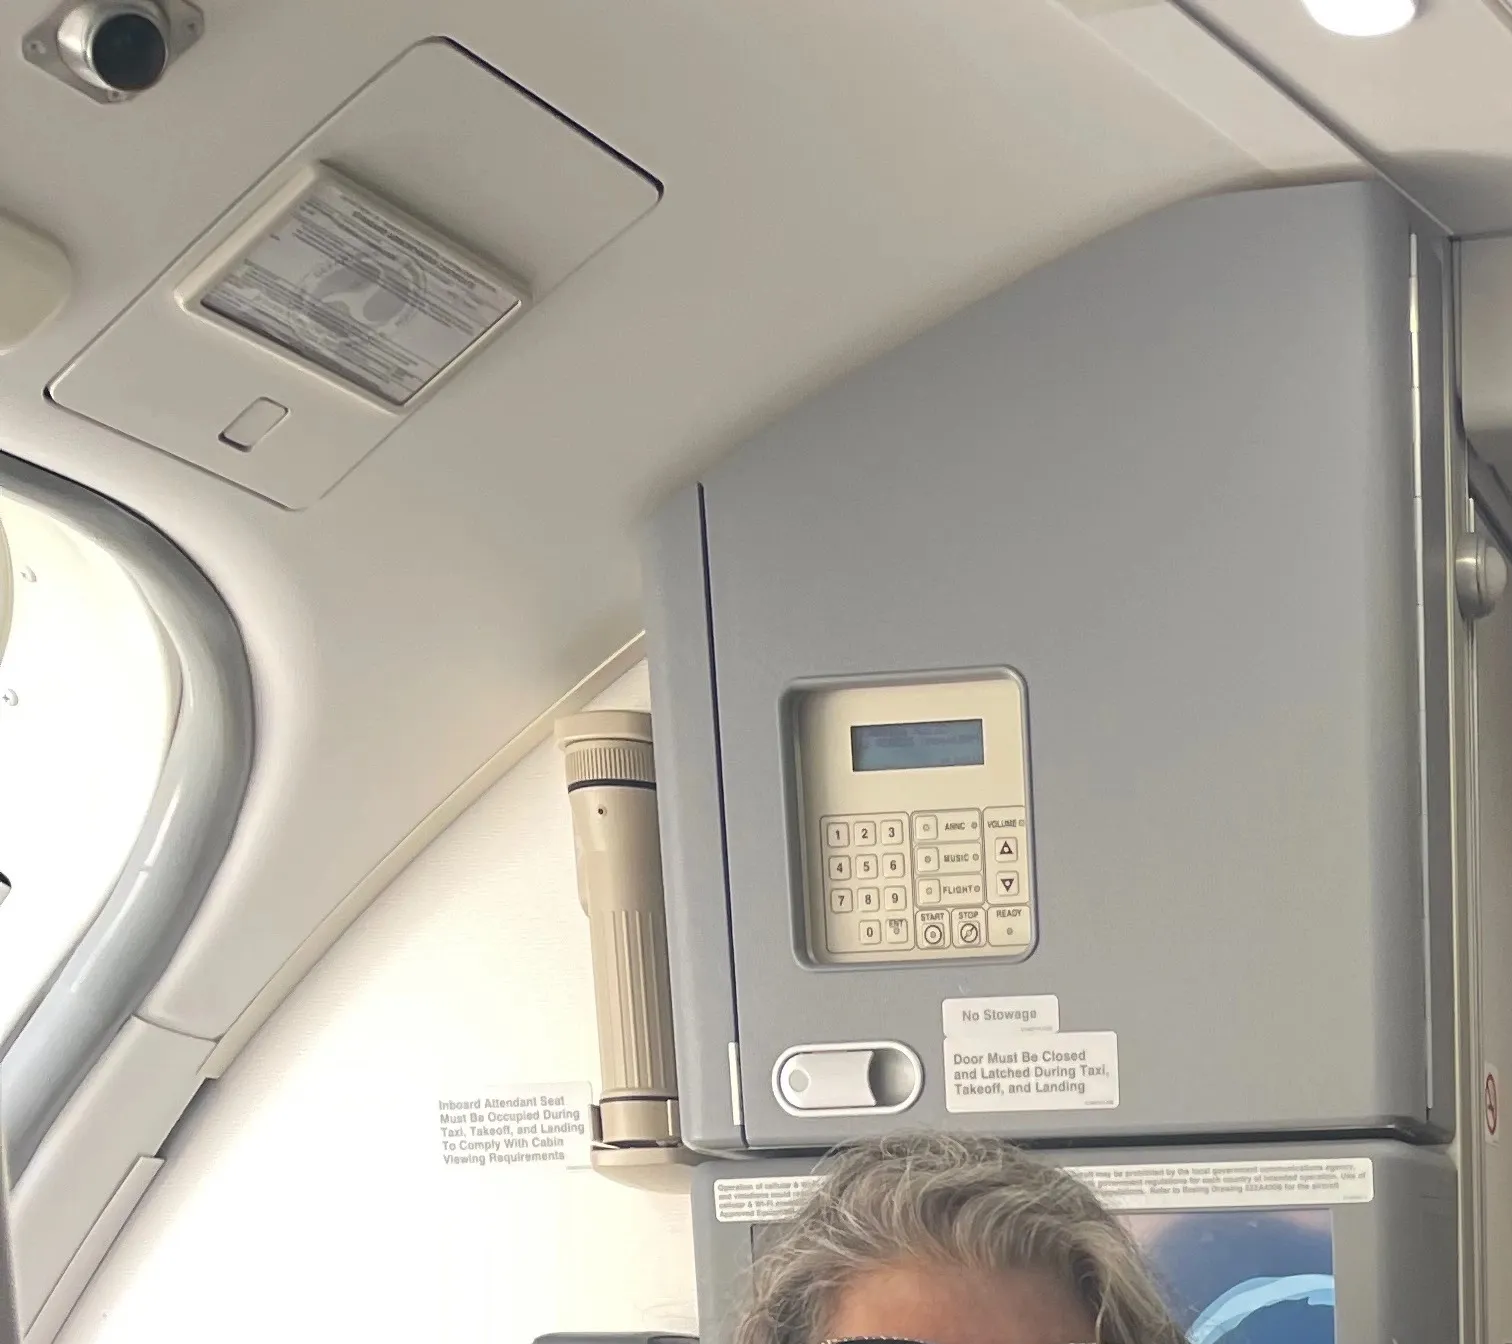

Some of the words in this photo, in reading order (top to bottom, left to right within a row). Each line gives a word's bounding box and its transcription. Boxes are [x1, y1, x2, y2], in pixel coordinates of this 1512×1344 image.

[987, 819, 1017, 829] VOLUME
[835, 830, 840, 840] 1
[861, 828, 869, 839] 2
[888, 827, 895, 838] 3
[943, 853, 970, 863] MUSIC
[836, 862, 843, 873] 4
[863, 861, 870, 872] 5
[889, 860, 897, 871] 6
[942, 884, 973, 894] FLIGHT
[838, 896, 845, 906] 7
[864, 894, 872, 905] 8
[891, 893, 899, 903] 9
[920, 913, 945, 921] START
[958, 911, 979, 920] STOP
[996, 909, 1022, 918] READY
[866, 927, 873, 937] 0
[962, 1010, 980, 1022] No
[983, 1009, 1037, 1023] Stowage
[953, 1054, 984, 1065] Door
[987, 1052, 1018, 1064] Must
[1022, 1052, 1038, 1063] Be
[1042, 1050, 1086, 1062] Closed
[954, 1069, 977, 1080] and
[981, 1067, 1030, 1079] Latched
[1034, 1066, 1076, 1079] During
[1080, 1064, 1110, 1078] Taxi,
[955, 1083, 1005, 1096] Takeoff,
[1008, 1081, 1031, 1093] and
[1035, 1081, 1085, 1094] Landing
[438, 1098, 481, 1110] Inboard
[484, 1096, 538, 1109] Attendant
[540, 1095, 565, 1107] Seat
[440, 1112, 467, 1124] Must
[470, 1112, 485, 1123] Be
[487, 1110, 540, 1123] Occupied
[543, 1109, 580, 1121] During
[441, 1126, 467, 1138] Taxi,
[470, 1124, 514, 1137] Takeoff,
[517, 1123, 537, 1135] and
[540, 1122, 585, 1135] Landing
[442, 1140, 457, 1151] To
[459, 1139, 501, 1152] Comply
[503, 1137, 529, 1149] With
[532, 1136, 564, 1148] Cabin
[443, 1153, 486, 1166] Viewing
[489, 1151, 565, 1164] Requirements
